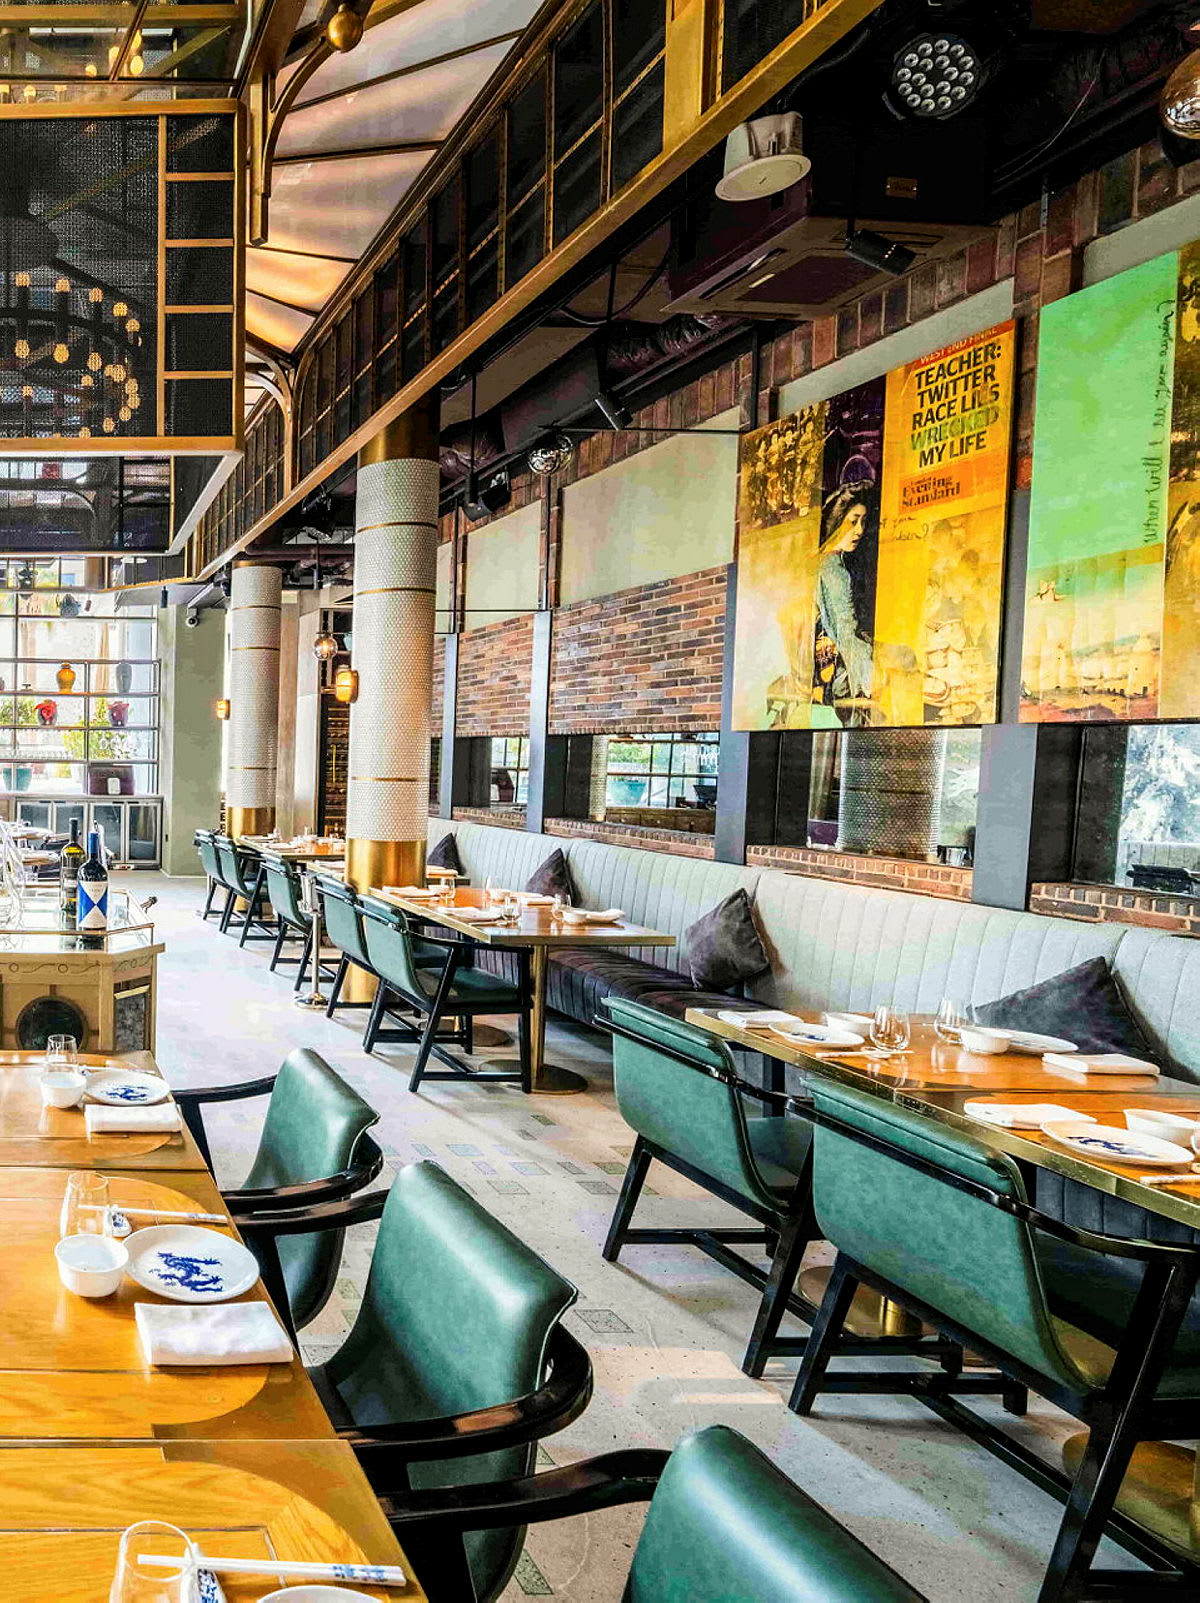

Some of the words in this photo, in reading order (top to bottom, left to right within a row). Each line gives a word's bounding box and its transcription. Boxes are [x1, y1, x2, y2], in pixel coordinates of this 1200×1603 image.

[915, 342, 1002, 390] TEACHER:
[917, 364, 996, 409] TWITTER
[911, 405, 1000, 451] WRECKED
[912, 398, 958, 431] RACE
[919, 442, 947, 468] MY
[949, 430, 987, 459] LIFE
